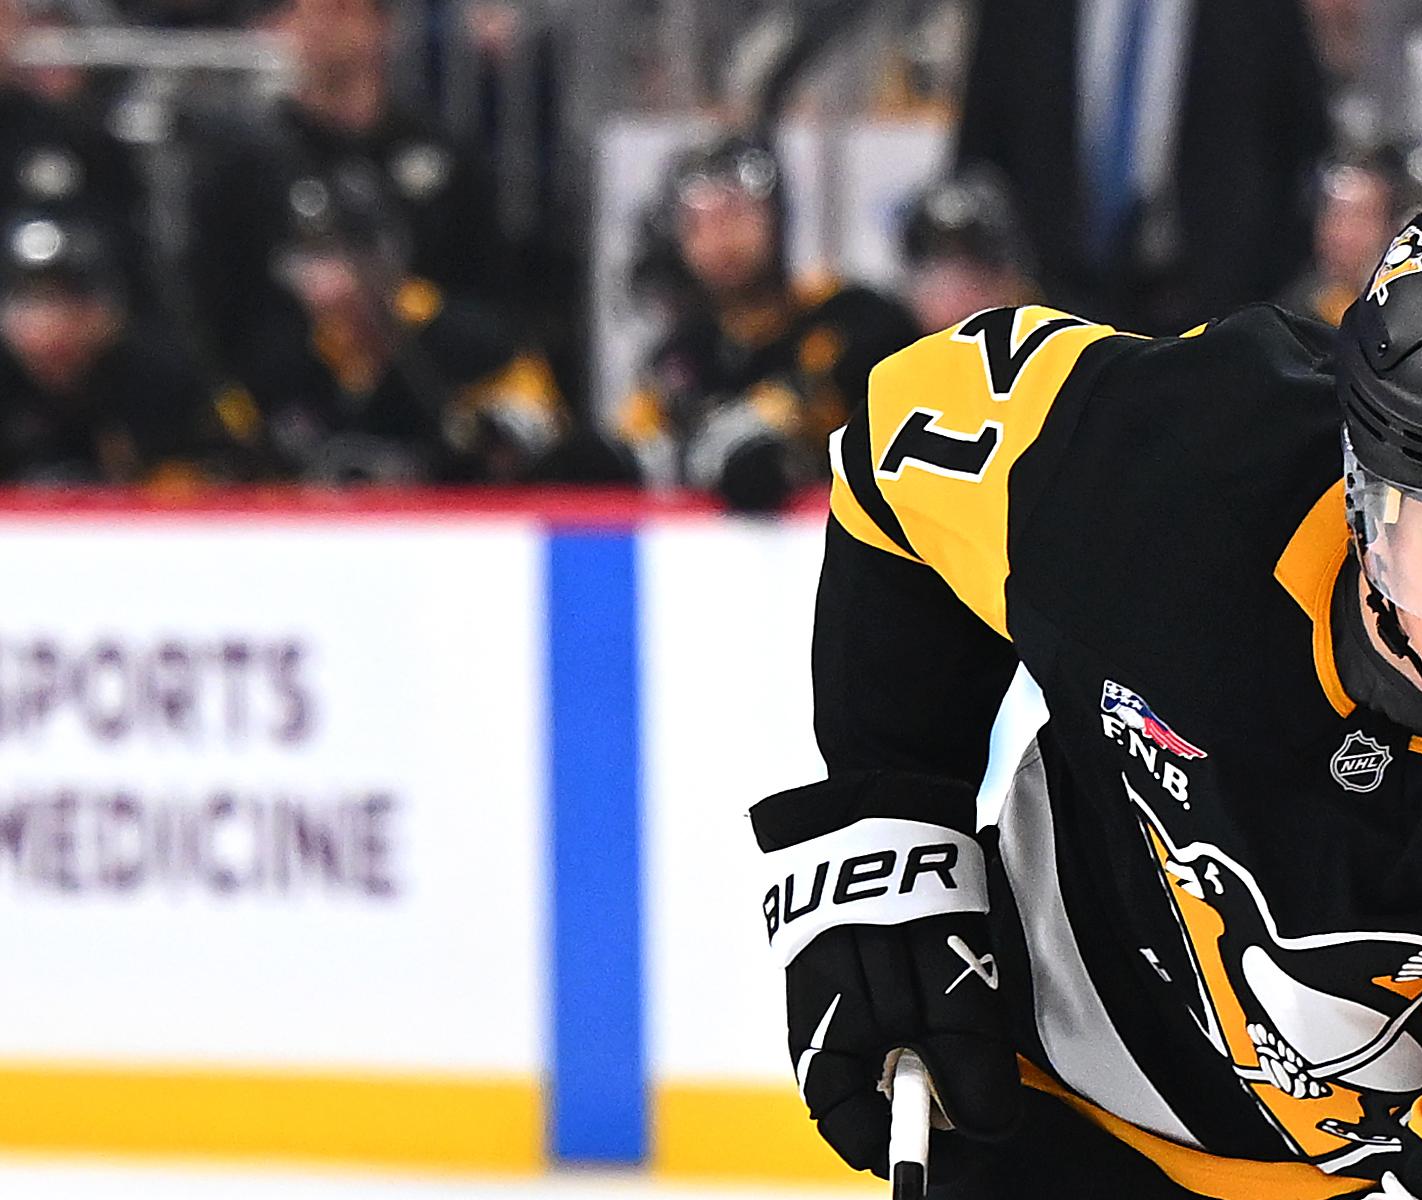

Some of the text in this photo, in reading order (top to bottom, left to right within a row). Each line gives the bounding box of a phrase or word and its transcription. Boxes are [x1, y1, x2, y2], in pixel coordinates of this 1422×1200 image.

[0, 636, 325, 746] PORTS
[1101, 713, 1191, 811] F.N.B.
[1339, 756, 1380, 773] NHL
[762, 842, 958, 947] AUER
